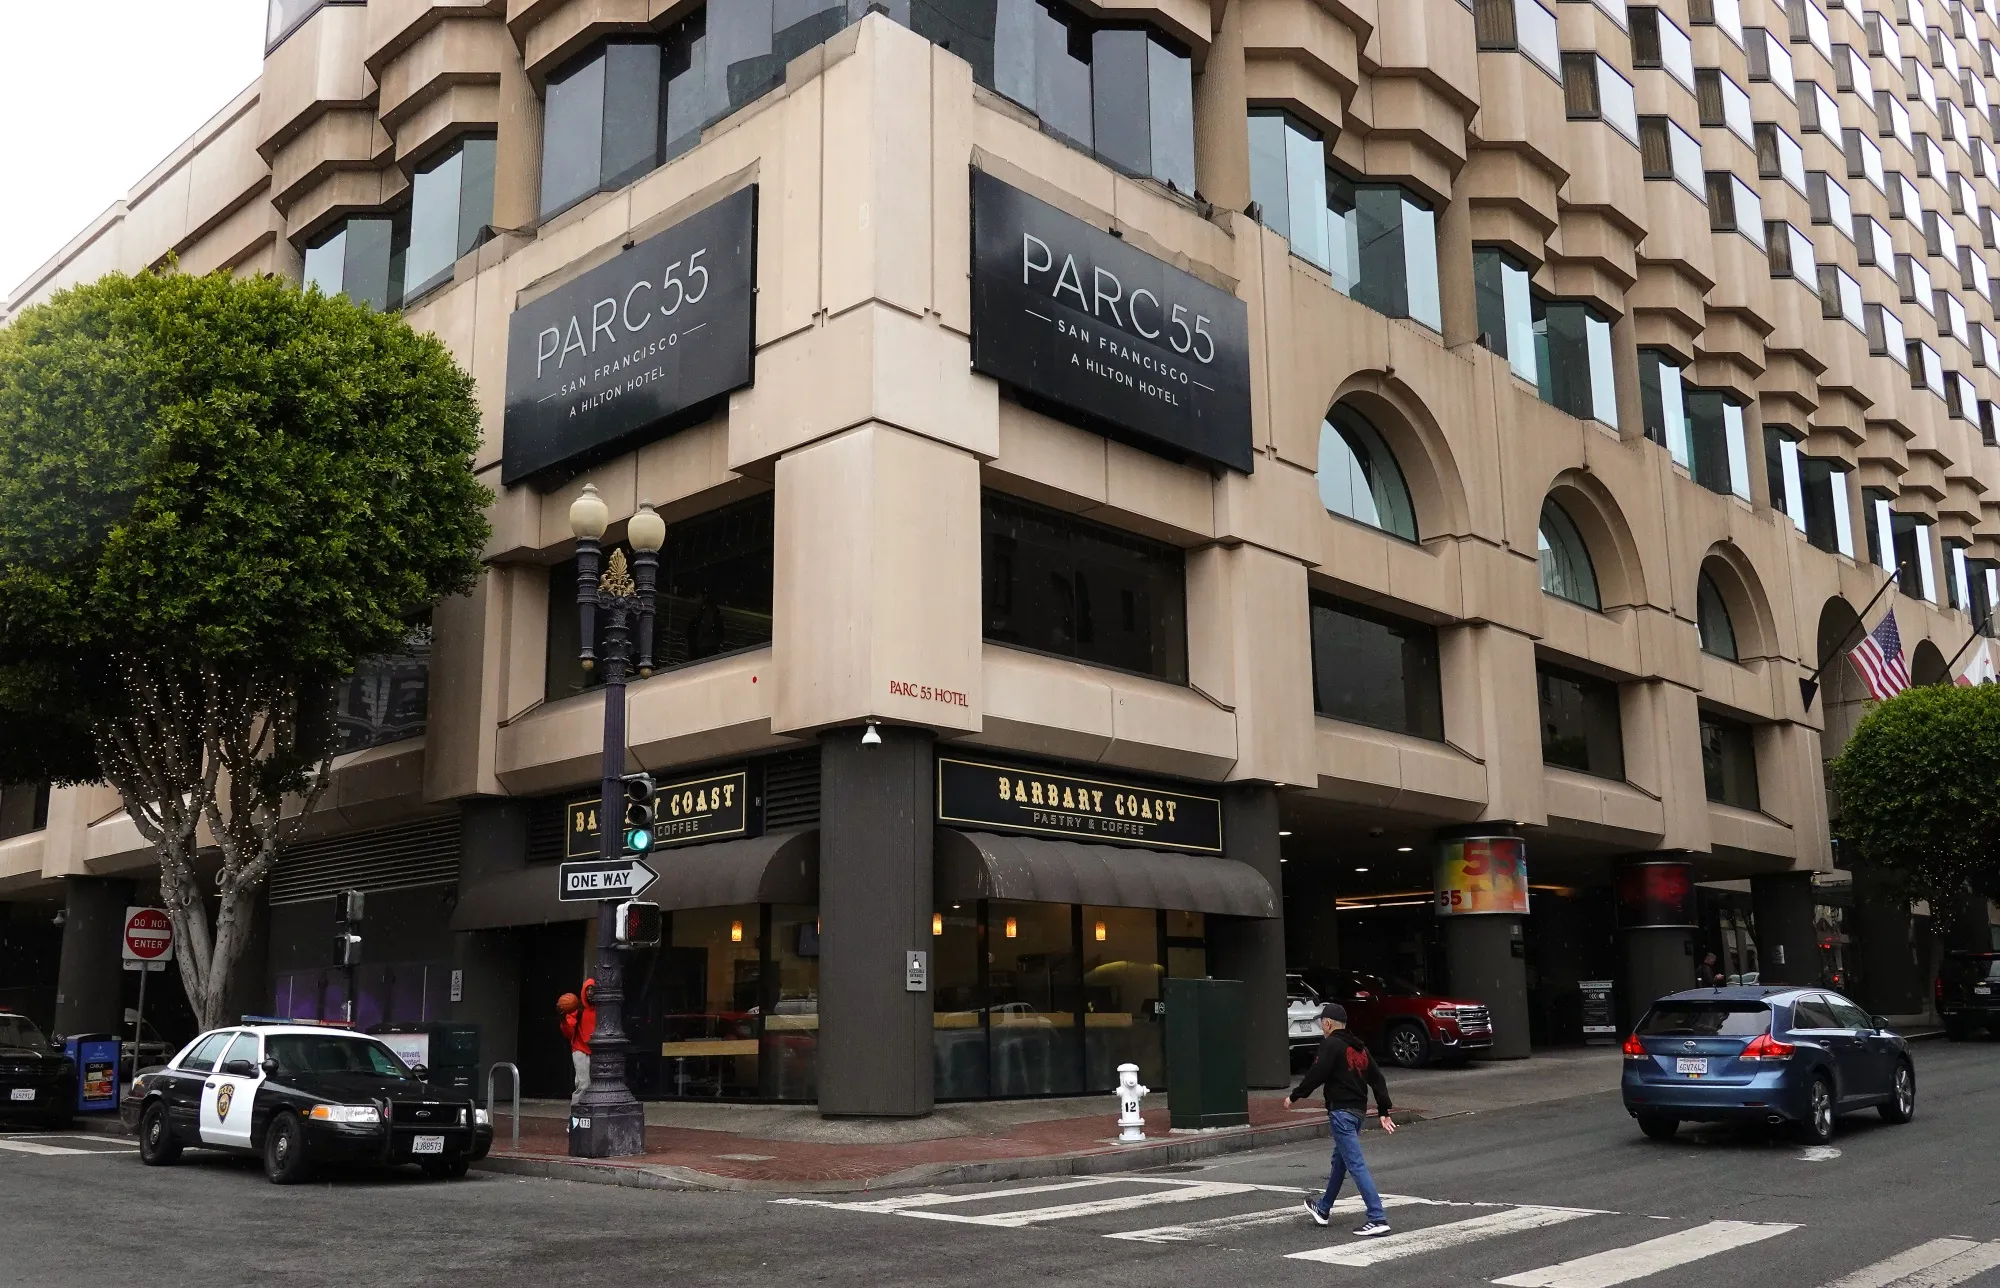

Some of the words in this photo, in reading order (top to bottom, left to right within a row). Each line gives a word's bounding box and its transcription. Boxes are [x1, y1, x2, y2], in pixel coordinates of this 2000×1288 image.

[537, 281, 652, 379] PARC
[660, 247, 709, 316] 55
[1023, 232, 1160, 339] PARC
[1169, 303, 1215, 364] 55
[561, 375, 586, 397] SAN
[594, 333, 678, 382] FRANCISCO
[1057, 319, 1090, 343] SAN
[1099, 337, 1188, 384] FRANCISCO
[569, 406, 577, 418] A
[581, 385, 622, 413] HILTON
[627, 366, 665, 392] HOTEL
[1071, 353, 1080, 367] A
[1086, 361, 1133, 388] HILTON
[1139, 380, 1179, 406] HOTEL
[890, 680, 919, 698] PARC
[920, 686, 932, 701] 55
[935, 687, 970, 708] HOTEL
[671, 783, 735, 817] COAST
[999, 776, 1104, 813] BARBARY
[1115, 793, 1177, 822] COAST
[657, 820, 699, 837] COFFEE
[1033, 812, 1082, 829] PASTRY
[1088, 819, 1096, 830] &
[1101, 820, 1145, 836] COFFEE
[1462, 840, 1517, 877] 55
[571, 873, 598, 888] ONE
[603, 872, 630, 886] WAY
[1440, 889, 1462, 907] 55
[134, 918, 146, 927] DO
[151, 919, 168, 928] NOT
[134, 939, 163, 949] ENTER
[1125, 1101, 1137, 1113] 12
